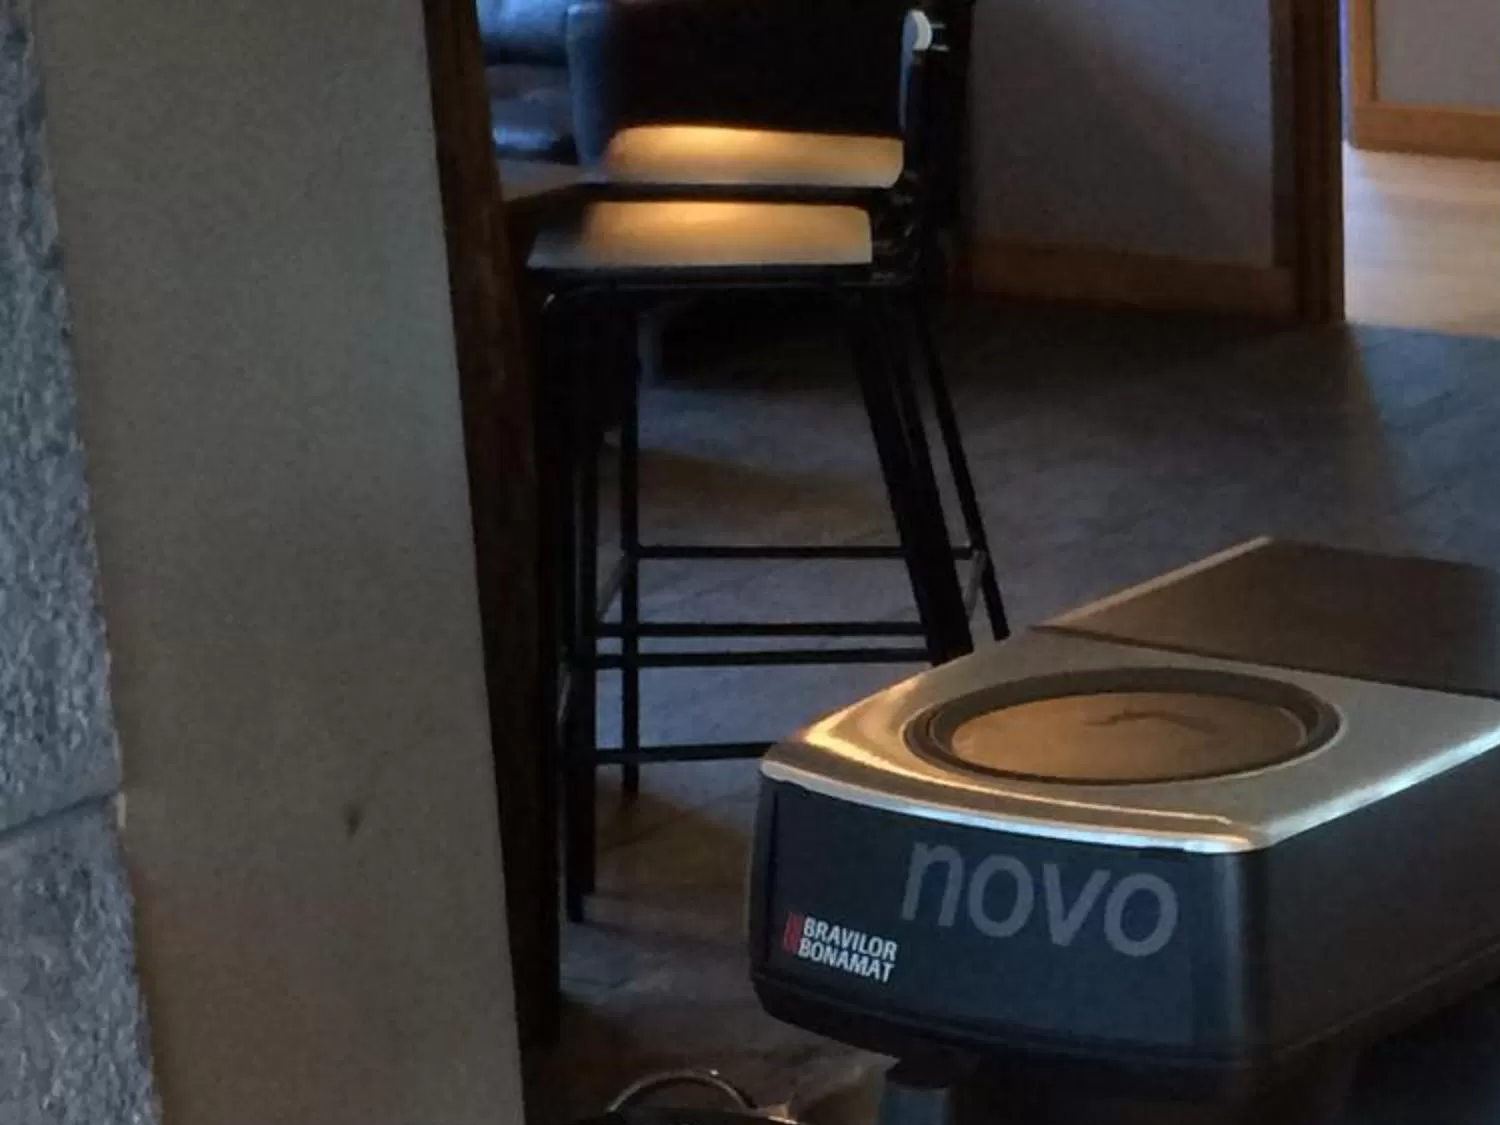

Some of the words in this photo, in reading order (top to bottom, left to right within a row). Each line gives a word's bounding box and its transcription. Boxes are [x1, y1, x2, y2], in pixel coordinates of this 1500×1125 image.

[902, 840, 1178, 957] novo
[798, 938, 895, 982] BONAMAT
[804, 917, 898, 961] BRAVILOR
